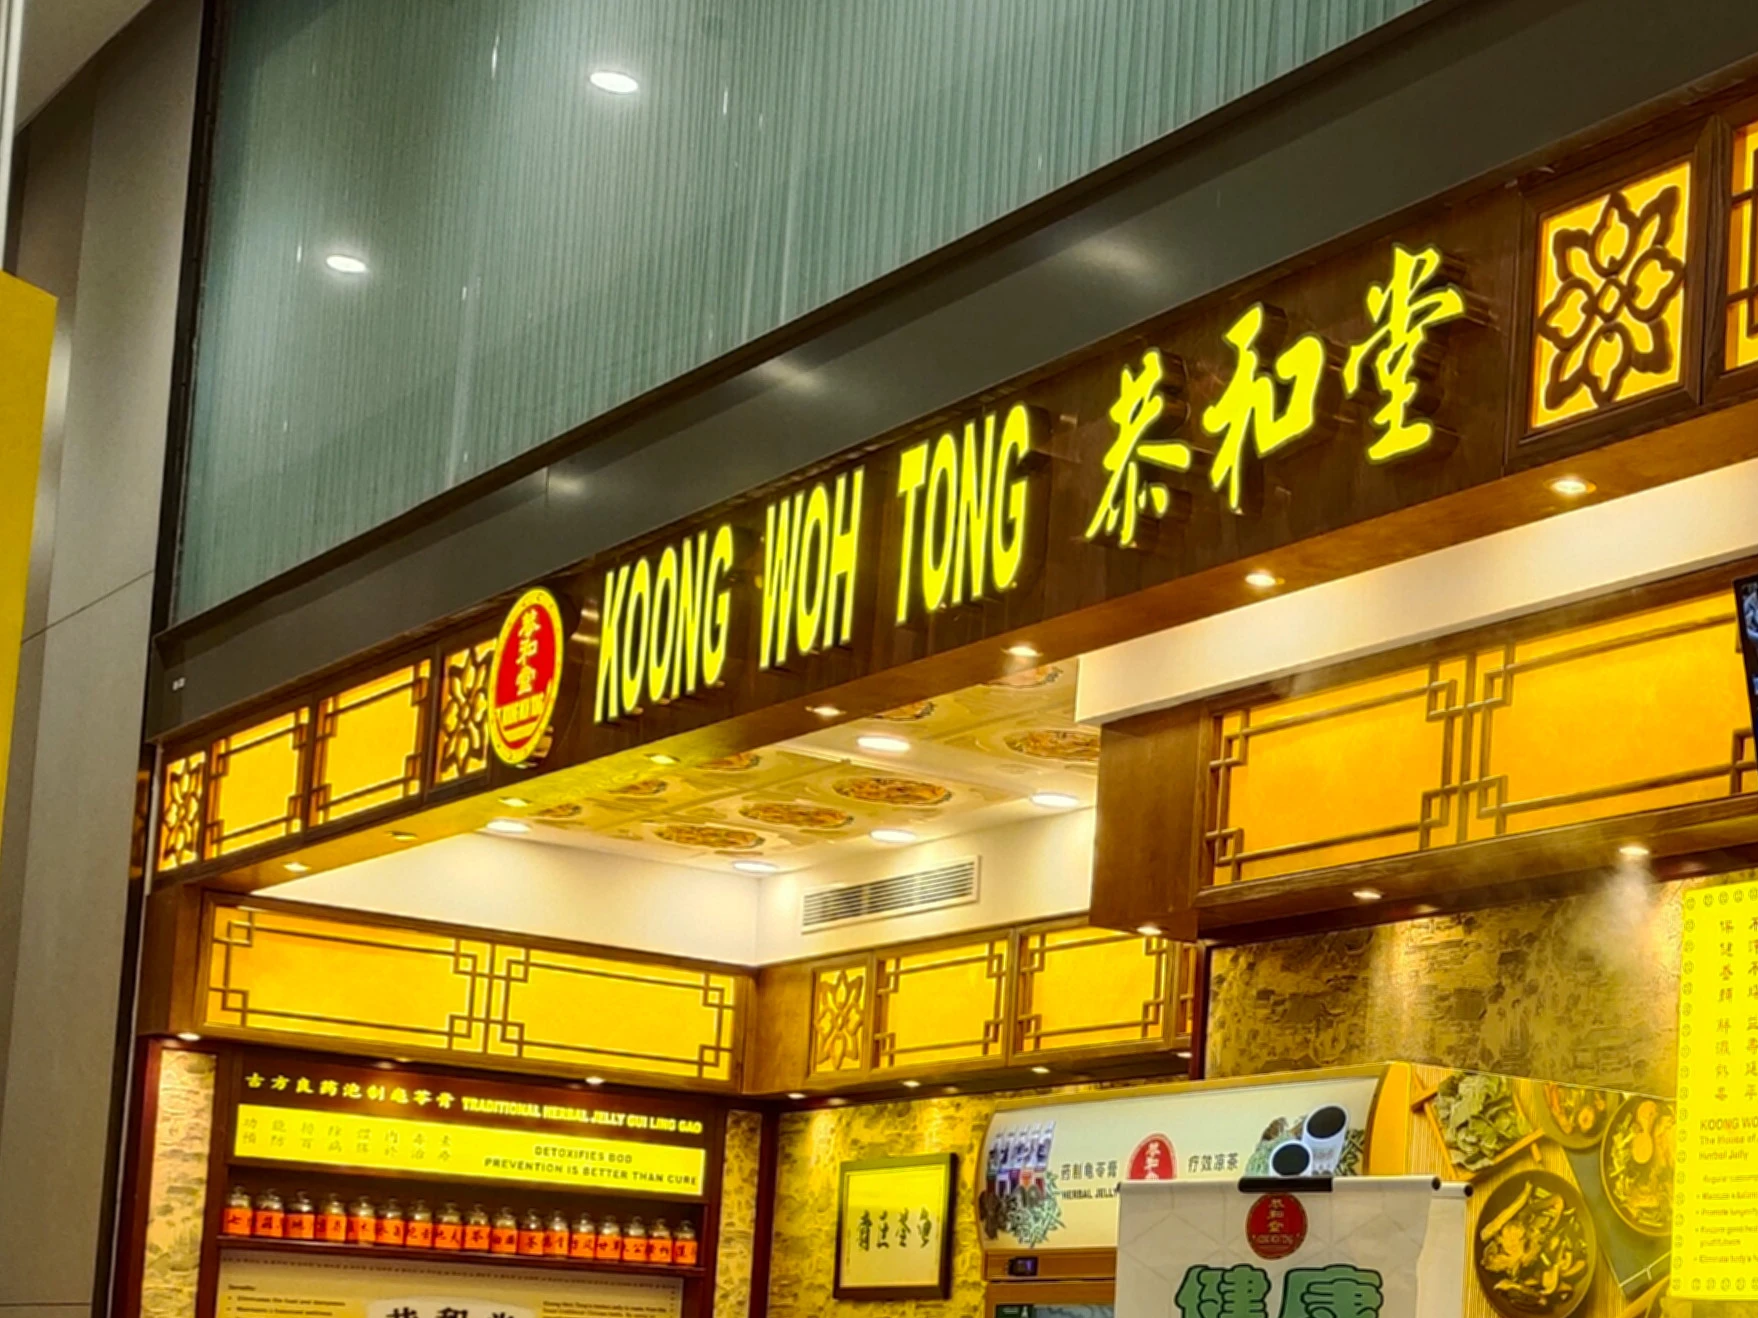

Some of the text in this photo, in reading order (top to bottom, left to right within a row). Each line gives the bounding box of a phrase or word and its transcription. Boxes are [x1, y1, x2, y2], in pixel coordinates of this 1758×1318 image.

[1087, 246, 1465, 547] 恭和堂
[595, 405, 1031, 723] KOONG WOH TONG
[462, 1097, 702, 1134] TRADITIONAL HERBAL JELLY GUI LING GAO
[1700, 1118, 1739, 1131] KOONG
[535, 1146, 604, 1162] DETOXIFIES
[485, 1158, 697, 1186] PREVENTION IS BETTER THAN CURE
[1061, 1187, 1118, 1200] HERBAL JELLY
